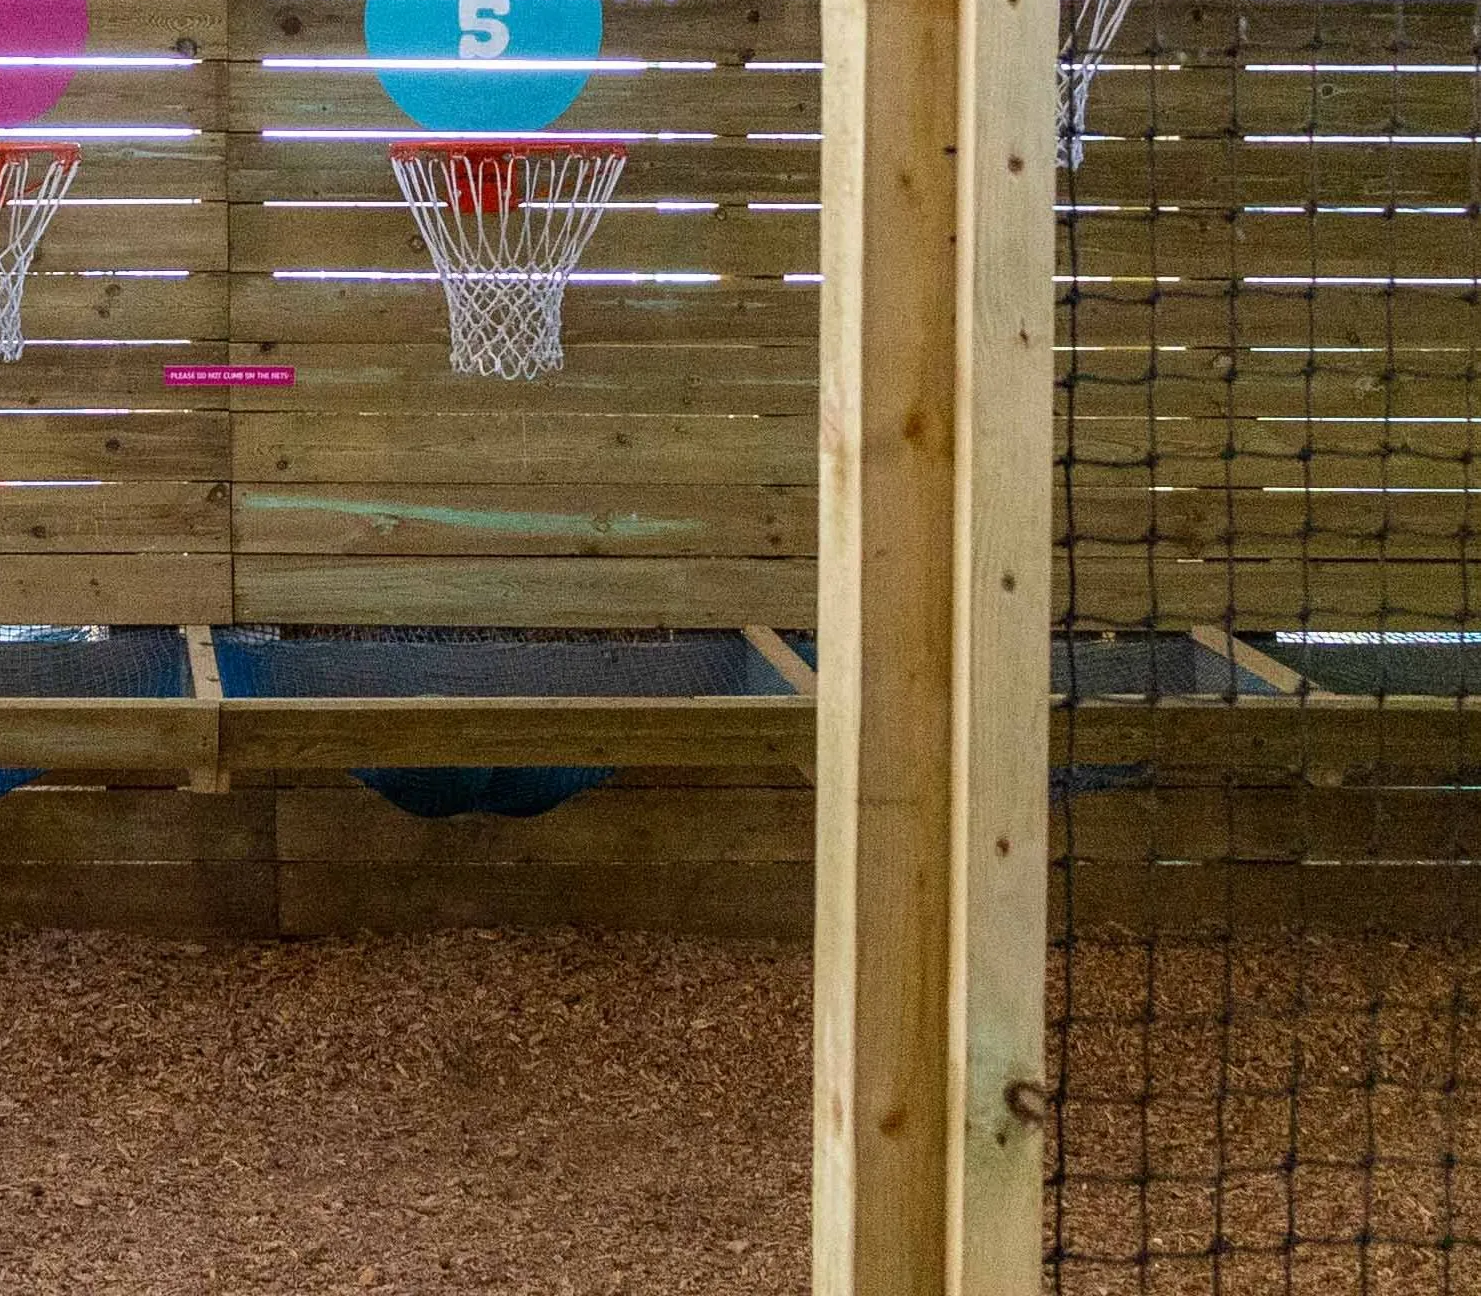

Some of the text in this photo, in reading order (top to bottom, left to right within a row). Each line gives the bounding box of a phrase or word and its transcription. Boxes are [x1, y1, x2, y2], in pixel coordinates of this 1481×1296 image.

[170, 371, 195, 380] PLEASE
[197, 371, 206, 380] DO
[208, 371, 221, 380] NOT
[223, 371, 243, 380] CLIMB
[257, 371, 269, 380] THE
